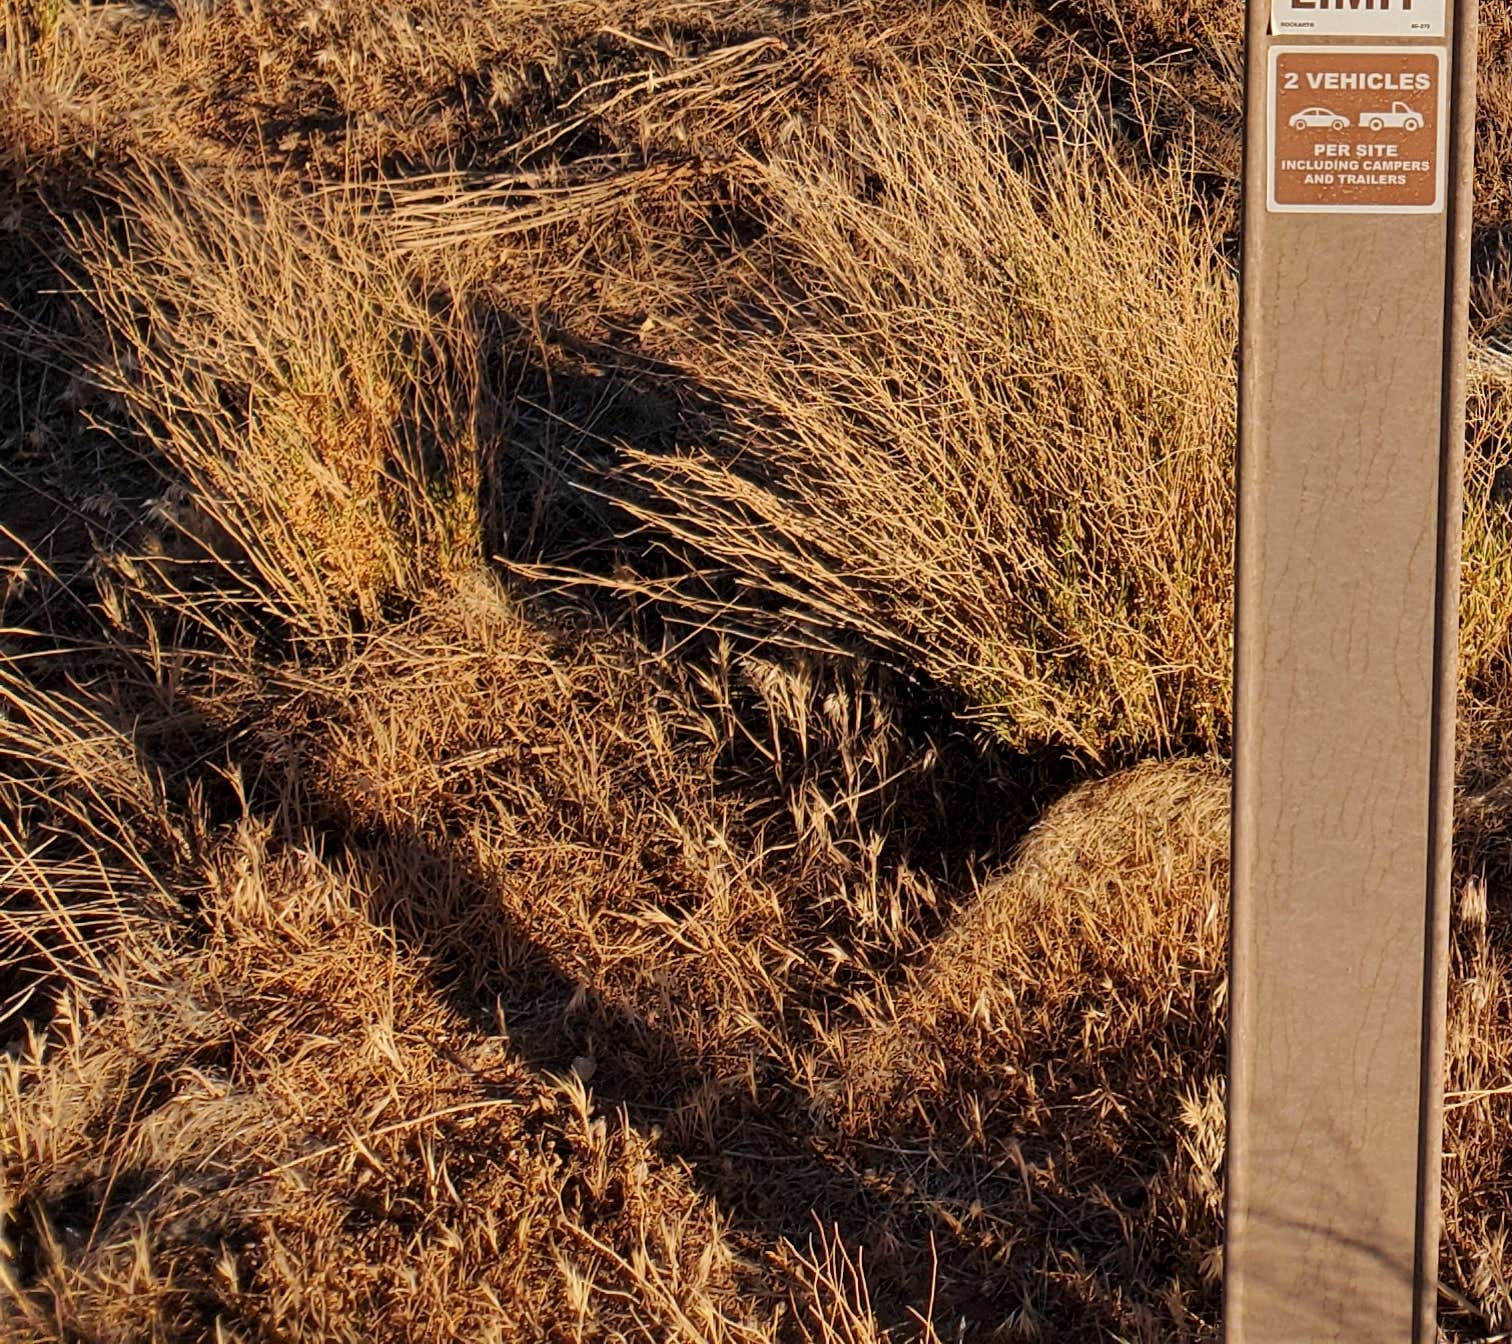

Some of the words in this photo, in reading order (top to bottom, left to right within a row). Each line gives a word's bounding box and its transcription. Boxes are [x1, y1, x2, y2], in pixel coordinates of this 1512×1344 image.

[1284, 72, 1300, 89] 2
[1305, 72, 1431, 90] VEHICLES
[1314, 144, 1350, 157] PER
[1356, 144, 1398, 157] SITE
[1281, 159, 1359, 171] INCLUDING
[1363, 160, 1430, 172] CAMPERS
[1304, 174, 1334, 184] AND
[1337, 174, 1407, 185] TRAILERS
